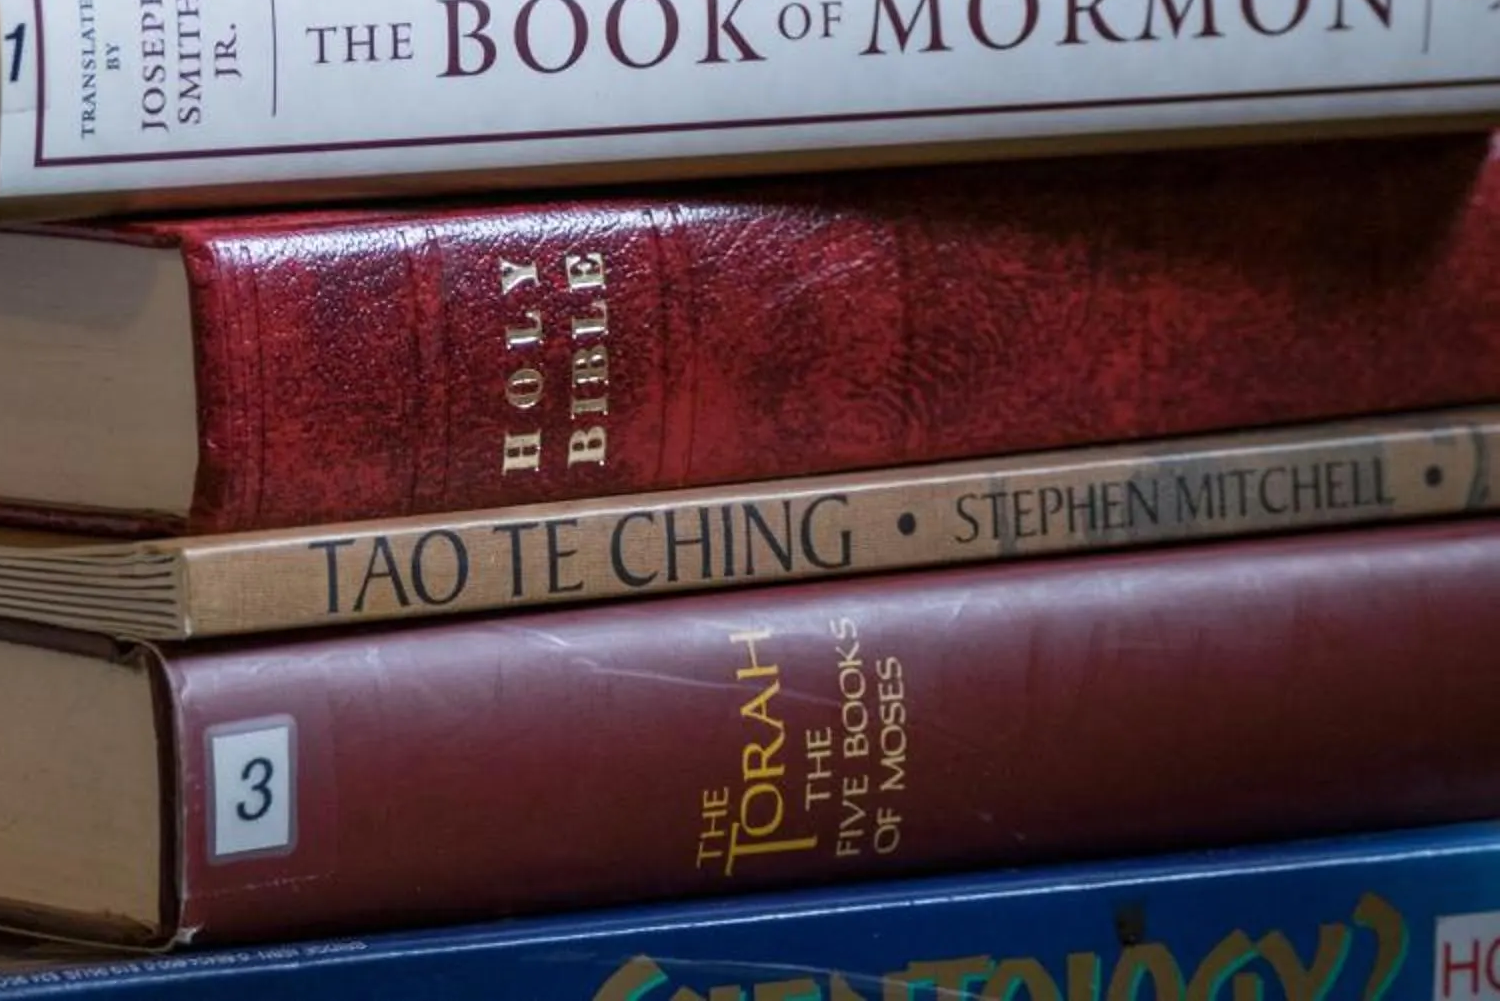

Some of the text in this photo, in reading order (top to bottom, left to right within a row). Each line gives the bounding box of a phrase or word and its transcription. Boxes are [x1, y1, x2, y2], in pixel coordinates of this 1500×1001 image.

[4, 22, 27, 83] 1
[105, 43, 121, 71] BY
[214, 22, 242, 78] JR.
[306, 21, 414, 66] THE
[777, 0, 842, 42] OF
[500, 260, 545, 476] HOLY
[566, 250, 611, 468] BIBLE
[954, 456, 1396, 545] STEPHEN MITCHELL
[309, 493, 852, 616] TAO TE CHING
[725, 627, 818, 876] TORAH
[805, 726, 832, 812] THE
[830, 616, 870, 857] FIVE BOOKS
[873, 655, 907, 854] OF MOSES
[236, 755, 275, 822] 3
[696, 786, 730, 868] THE
